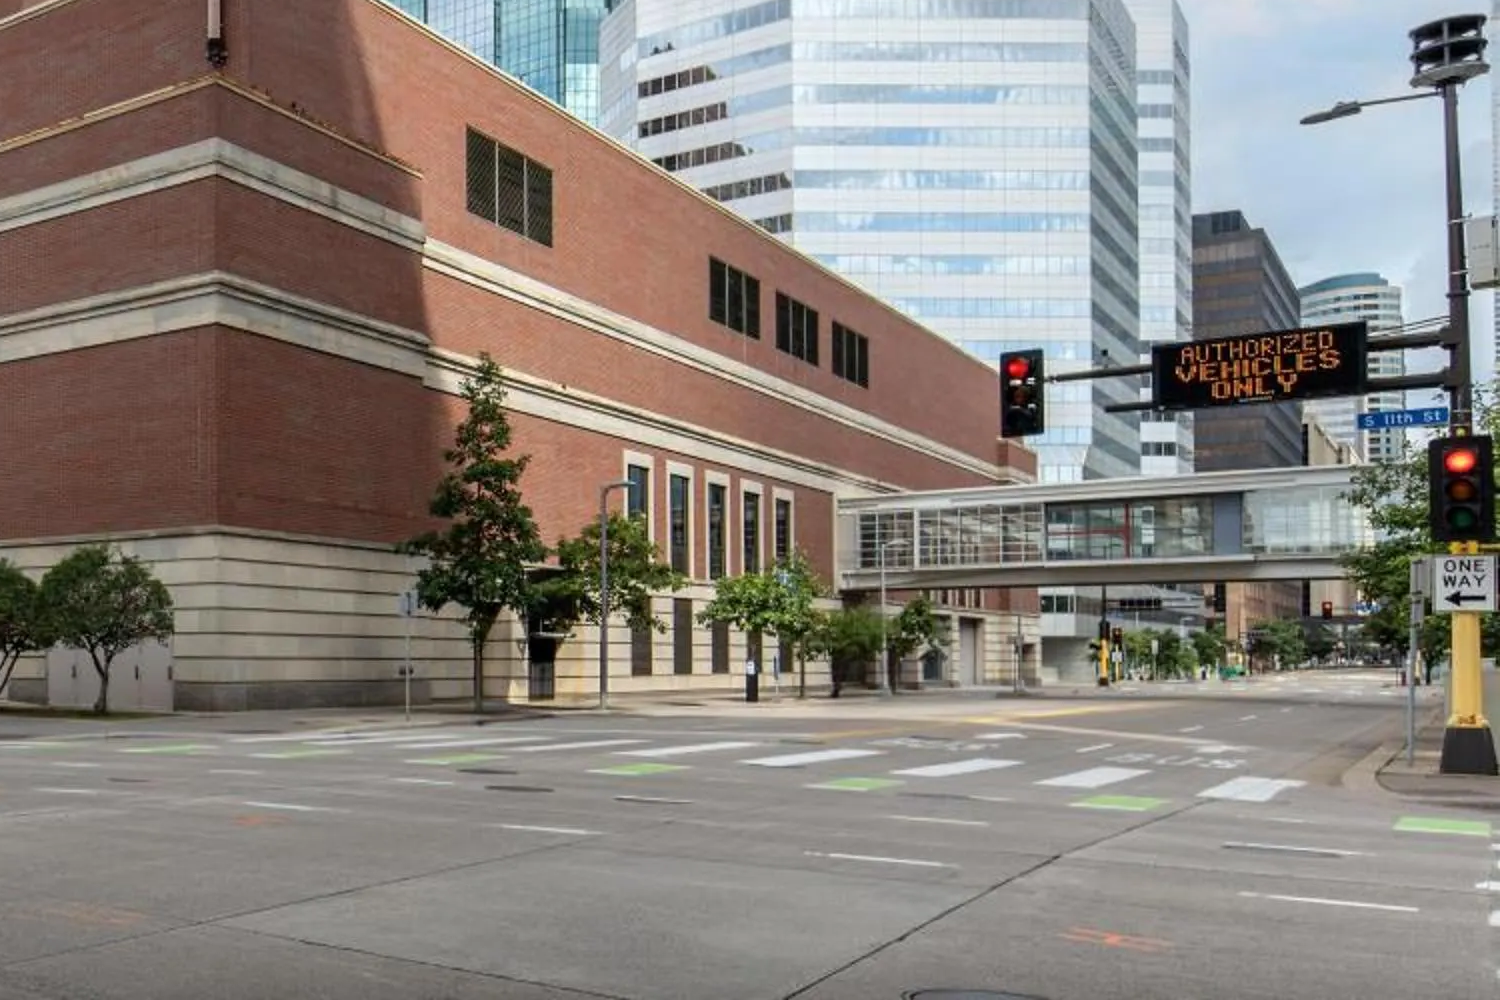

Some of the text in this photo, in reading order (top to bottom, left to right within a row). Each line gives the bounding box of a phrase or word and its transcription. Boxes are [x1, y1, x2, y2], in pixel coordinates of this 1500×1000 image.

[1181, 331, 1334, 365] AUTHORIZED
[1175, 350, 1341, 383] VEHICLES
[1211, 373, 1298, 399] ONLY
[1363, 410, 1441, 427] S 11th St
[1443, 559, 1485, 573] ONE
[1443, 574, 1487, 588] WAY
